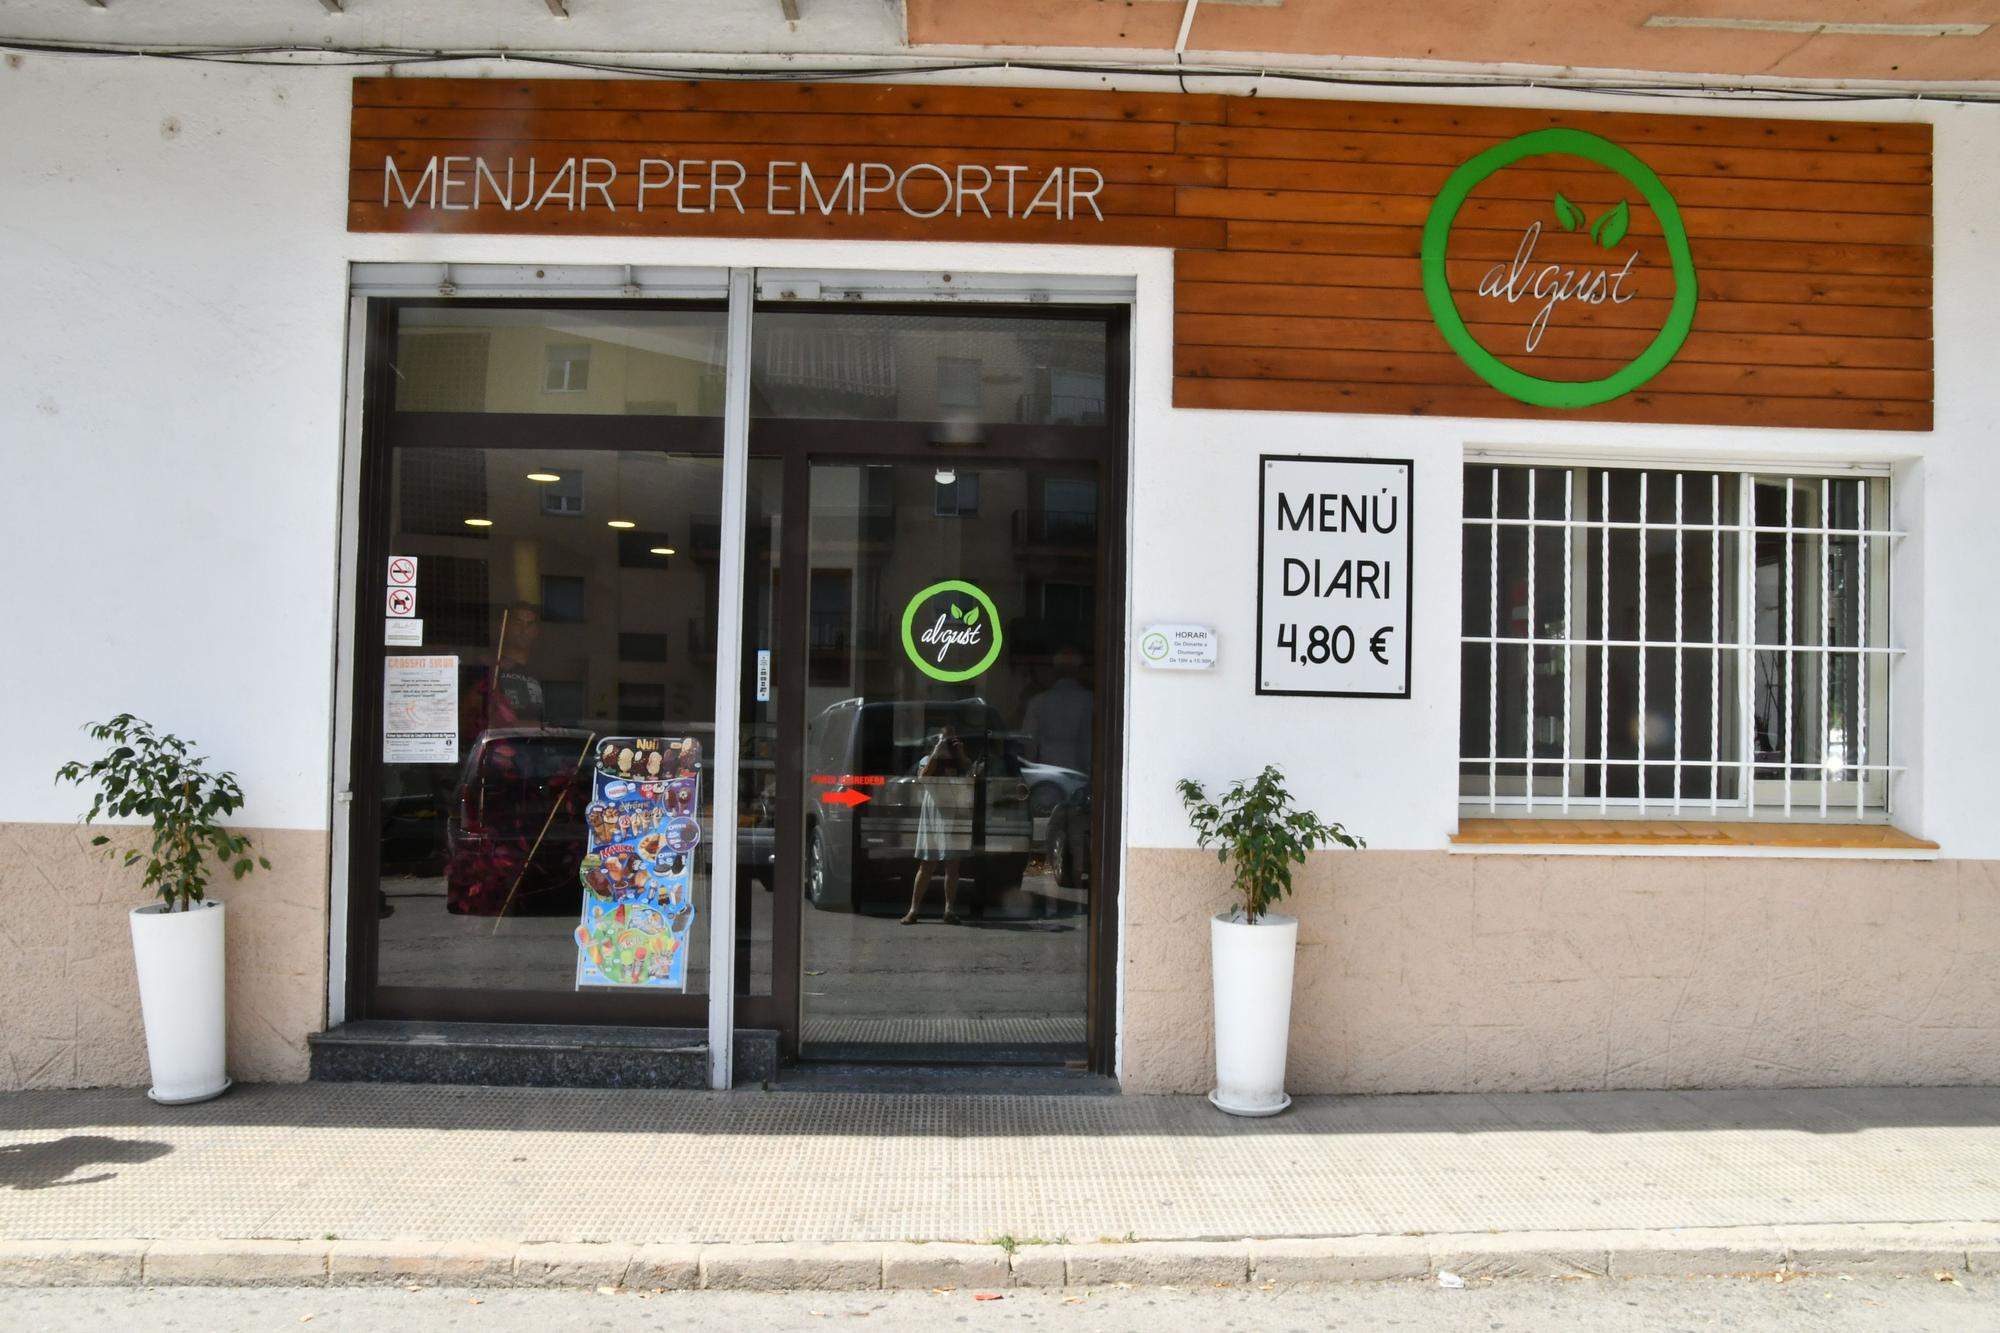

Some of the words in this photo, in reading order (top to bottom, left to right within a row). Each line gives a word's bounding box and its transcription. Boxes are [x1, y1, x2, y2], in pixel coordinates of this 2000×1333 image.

[383, 155, 617, 212] MENJAR
[637, 159, 746, 214] PER
[767, 161, 1104, 222] EMPORTAR
[1277, 487, 1398, 534] MENÚ
[1283, 557, 1390, 600] DIARI
[1175, 631, 1208, 639] HORARI
[1277, 624, 1355, 667] 4,80
[1369, 626, 1394, 666] €
